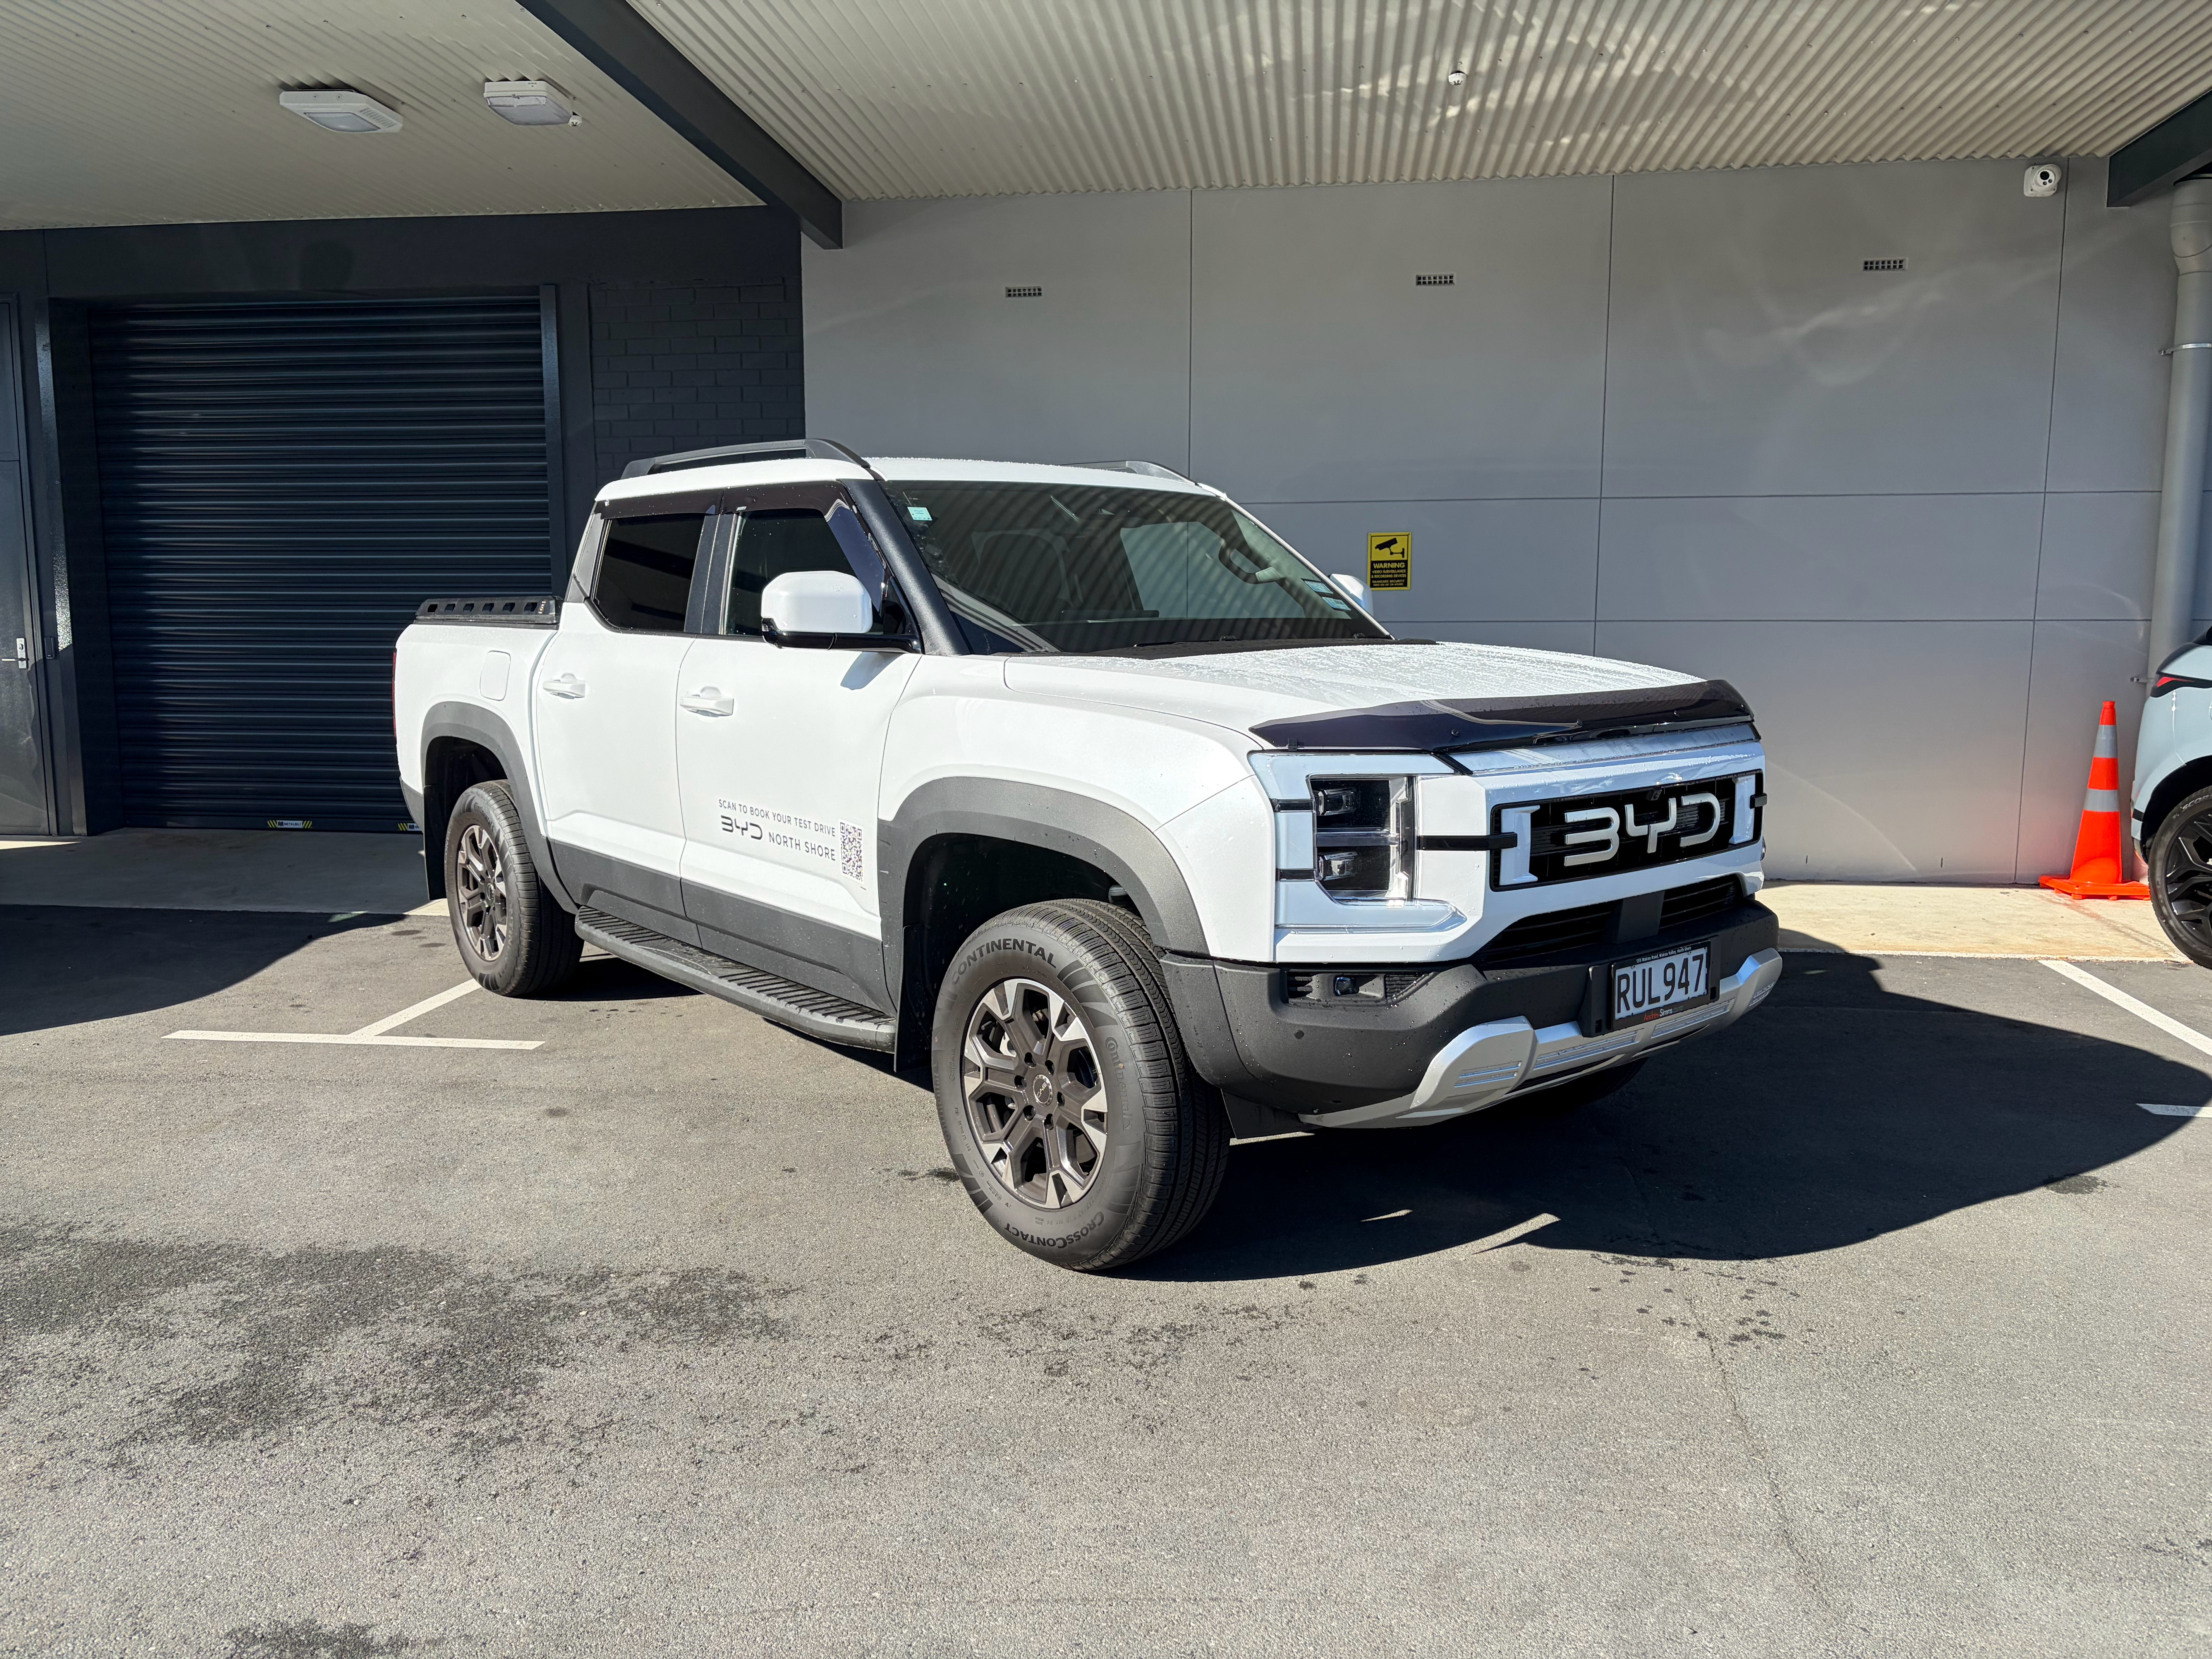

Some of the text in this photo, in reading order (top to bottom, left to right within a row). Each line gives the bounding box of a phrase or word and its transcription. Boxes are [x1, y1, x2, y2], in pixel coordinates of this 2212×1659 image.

[719, 799, 835, 837] SCAN TO BOOK YOUR TEST DRIVE
[721, 815, 835, 861] BYD NORTH SHORE
[1565, 792, 1720, 867] BYD
[951, 938, 1056, 985] CONTINENTAL
[1617, 953, 1704, 1013] RUL947
